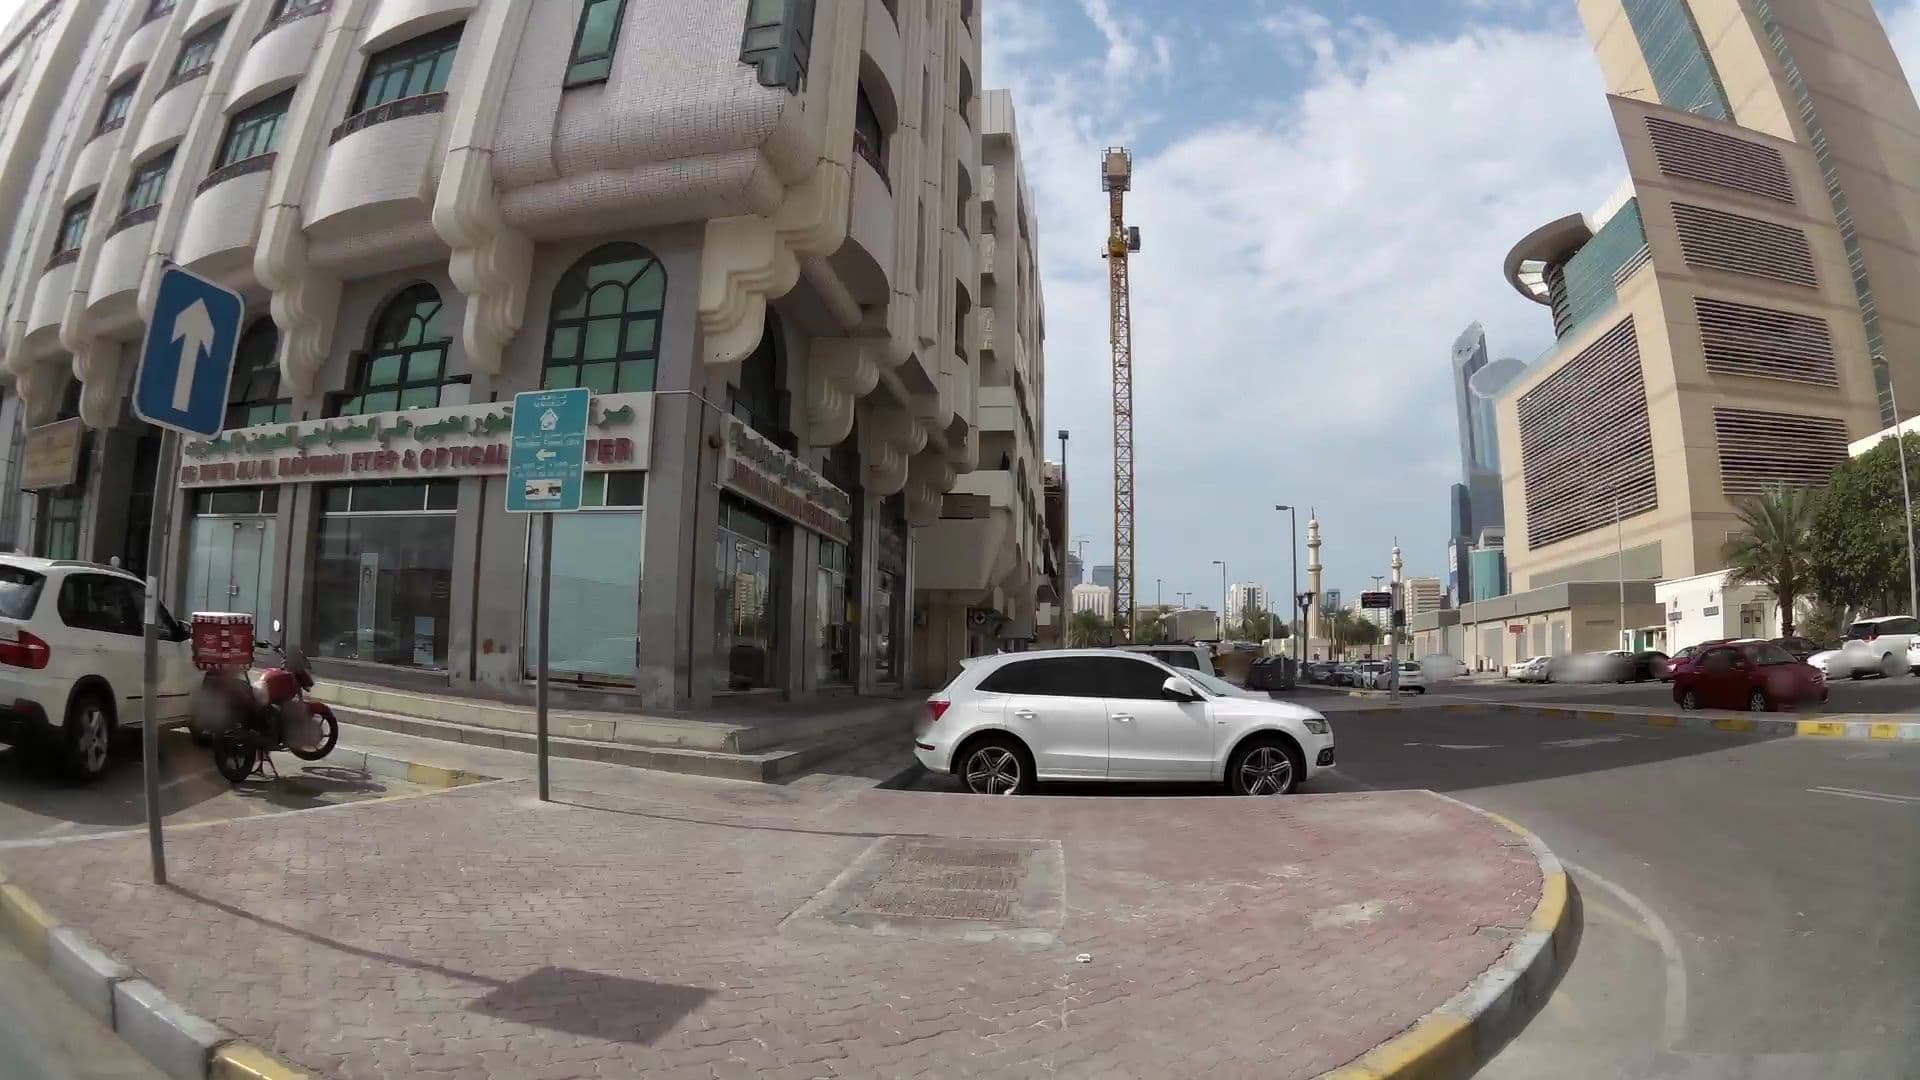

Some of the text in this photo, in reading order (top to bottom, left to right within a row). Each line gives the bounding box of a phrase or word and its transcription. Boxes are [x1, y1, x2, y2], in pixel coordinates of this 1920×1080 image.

[351, 450, 401, 473] EYES
[420, 443, 509, 471] OPTICAL
[586, 437, 635, 465] TER
